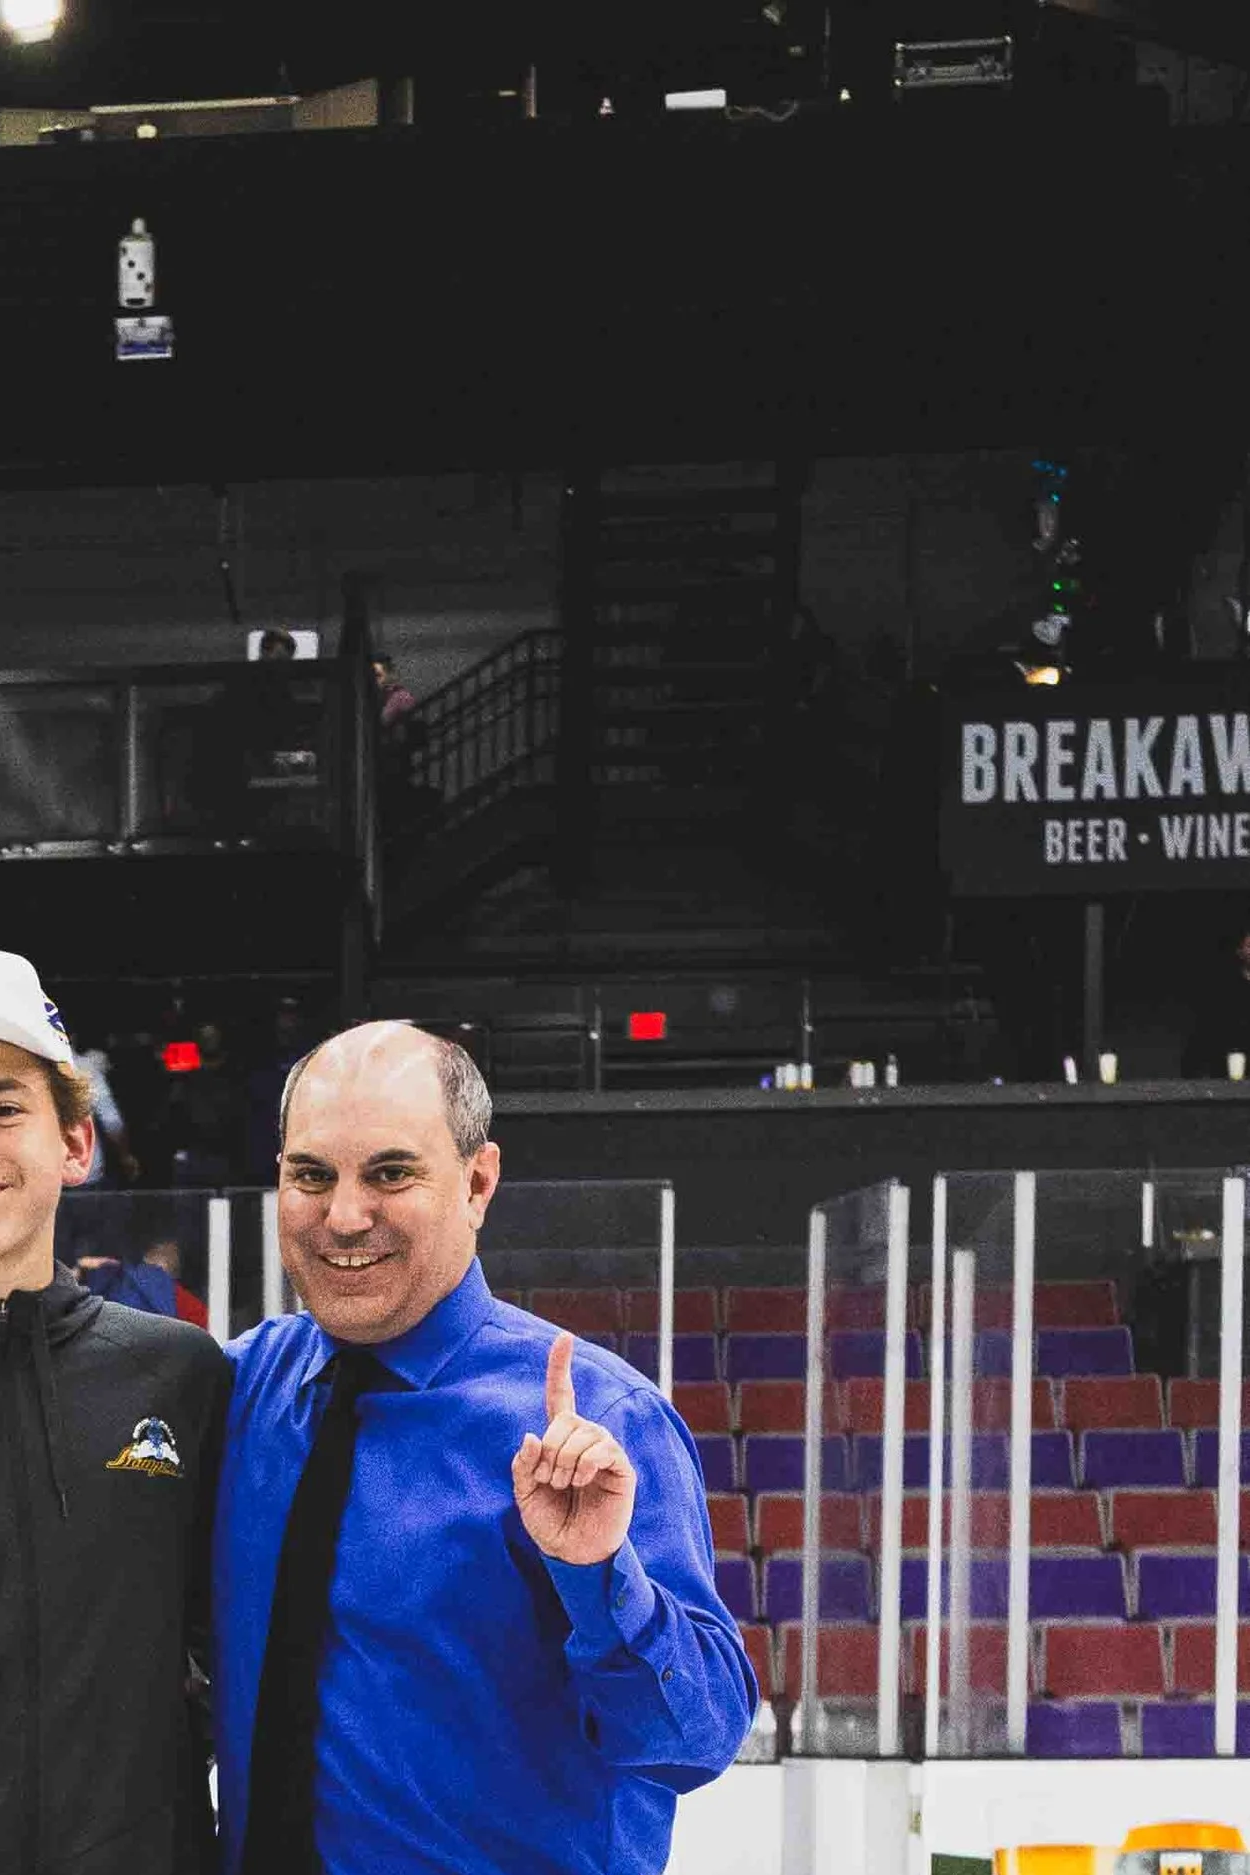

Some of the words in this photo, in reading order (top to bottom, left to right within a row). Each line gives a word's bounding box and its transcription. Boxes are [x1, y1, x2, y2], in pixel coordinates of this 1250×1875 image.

[961, 713, 1250, 802] BREAKAW
[1044, 818, 1127, 863] BEER
[1159, 813, 1250, 859] WINE
